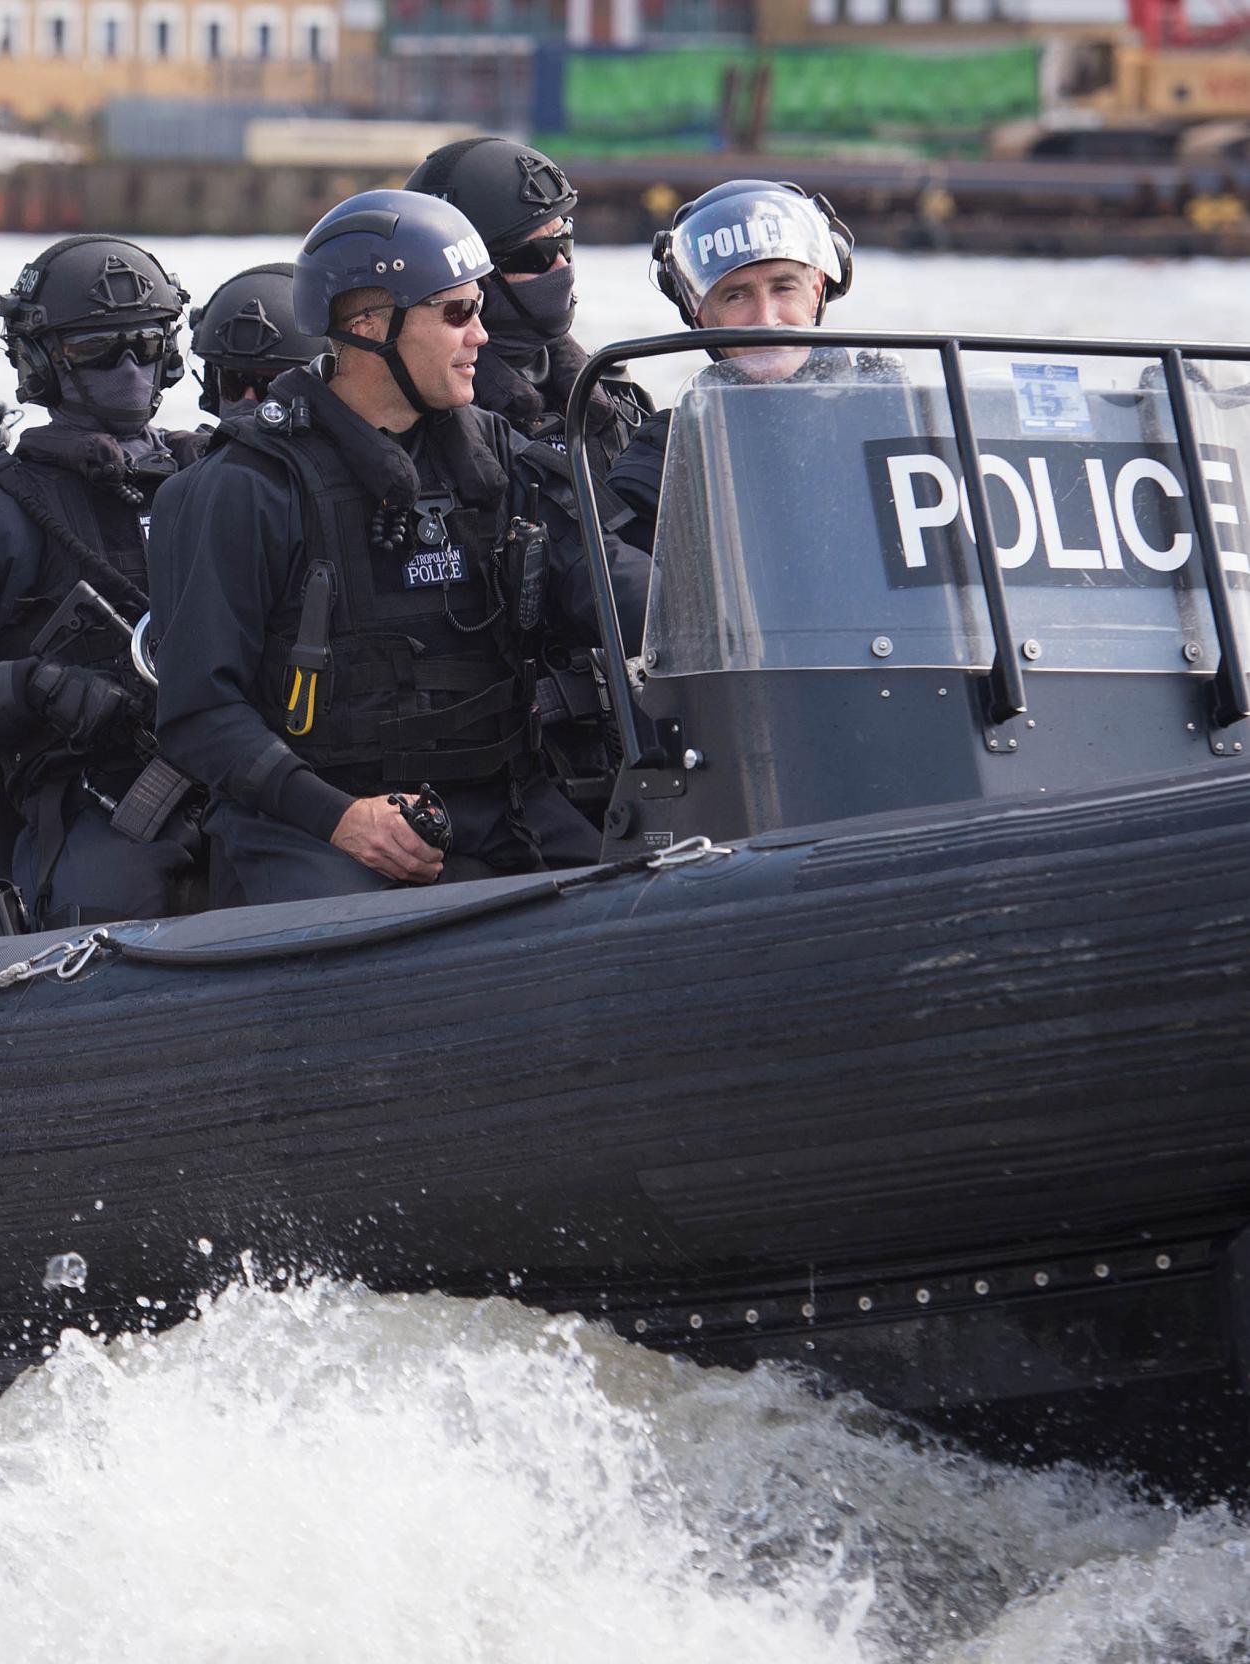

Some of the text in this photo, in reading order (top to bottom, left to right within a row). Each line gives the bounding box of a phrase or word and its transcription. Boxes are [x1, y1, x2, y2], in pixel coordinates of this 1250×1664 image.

[443, 234, 488, 277] POL
[887, 453, 1250, 572] POLICE
[407, 561, 462, 584] POLICE
